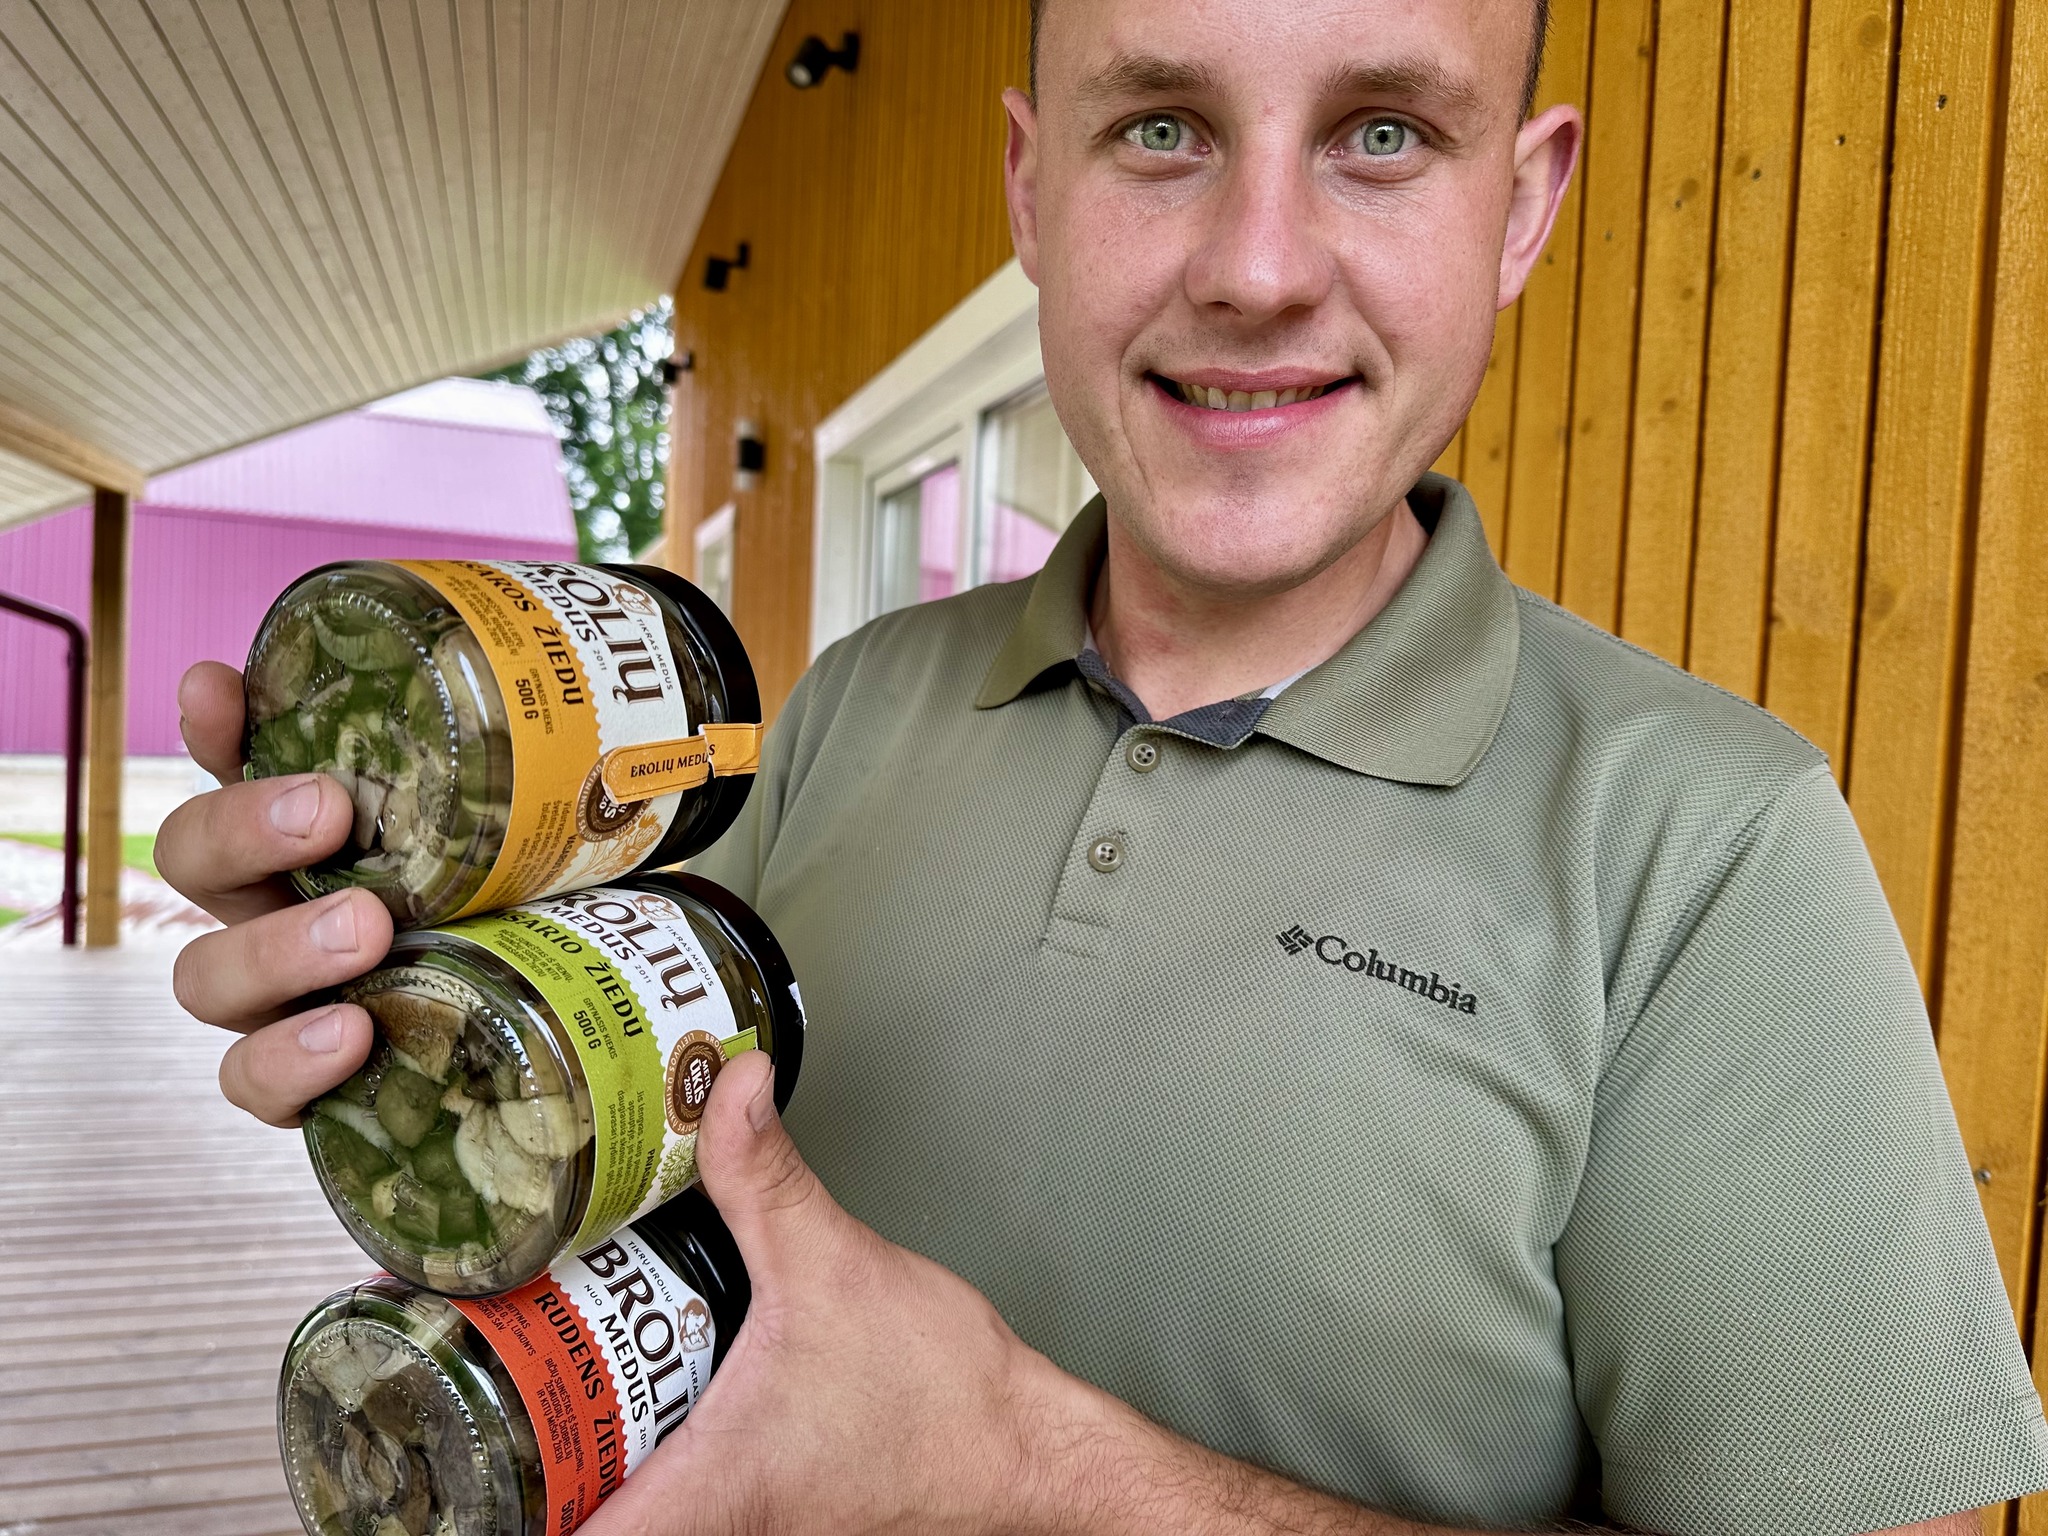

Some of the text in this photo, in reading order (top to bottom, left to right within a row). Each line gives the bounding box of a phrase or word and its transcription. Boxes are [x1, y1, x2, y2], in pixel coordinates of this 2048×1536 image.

[515, 571, 607, 671] MEDUS 2011
[518, 560, 664, 707] ROLIŲ
[533, 625, 584, 705] ŽIEDŲ
[637, 618, 673, 690] TIKRAS MEDUS
[515, 678, 539, 720] 500 G
[529, 668, 554, 735] GRYNASIS KIEKIS
[677, 744, 716, 769] MEDUS
[542, 906, 652, 984] MEDUS 2011
[555, 892, 708, 1012] ROLIŲ
[664, 925, 715, 987] TIKRAS MEDUS
[1315, 935, 1477, 1015] Columbia
[573, 1010, 602, 1050] 500 G
[583, 998, 618, 1059] GRYNASIS KIEKIS
[584, 961, 644, 1038] ŽIEDŲ
[669, 1032, 695, 1072] LIETUVOS
[702, 1059, 711, 1089] METŲ
[705, 1033, 727, 1062] BROLIŲ
[637, 1090, 645, 1102] Jis
[684, 1076, 693, 1104] 2020
[690, 1058, 705, 1104] ŪKIS
[677, 1122, 698, 1133] SĄJUN
[584, 1284, 603, 1306] NUO
[628, 1241, 673, 1303] TIKRŲ BROLIŲ
[471, 1300, 506, 1333] PIŠKIO SAV.
[499, 1311, 508, 1319] G.
[505, 1318, 513, 1326] 1,
[511, 1325, 536, 1356] LUKONYS
[505, 1303, 531, 1330] BITYNAS
[533, 1291, 604, 1400] RUDENS
[599, 1313, 649, 1450] MEDUS 2011
[690, 1359, 700, 1399] TIKRAS
[536, 1388, 564, 1464] IR KITŲ MIŠKO ŽIEDŲ
[544, 1379, 574, 1460] ŽEMUOGIŲ, ČIOBRELIŲ
[545, 1358, 584, 1474] BIČIŲ SUNEŠTAS IŠ ŠERMUKŠNIŲ,
[560, 1499, 575, 1529] 500
